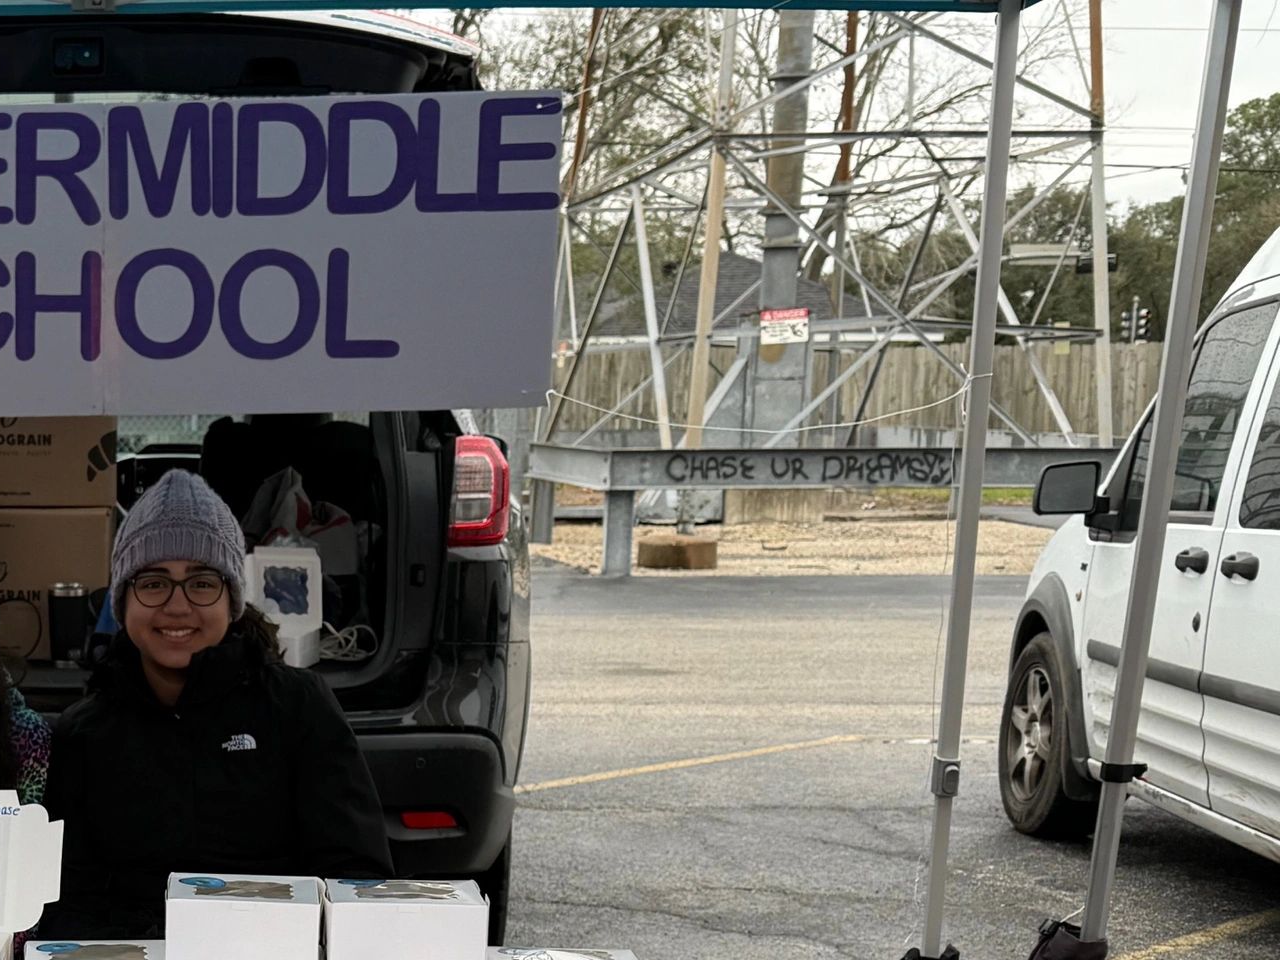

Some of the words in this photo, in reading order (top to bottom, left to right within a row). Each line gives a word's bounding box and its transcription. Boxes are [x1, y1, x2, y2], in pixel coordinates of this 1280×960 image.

[109, 96, 562, 219] MIDDLE
[665, 453, 755, 482] CHASE
[770, 457, 809, 479] UR
